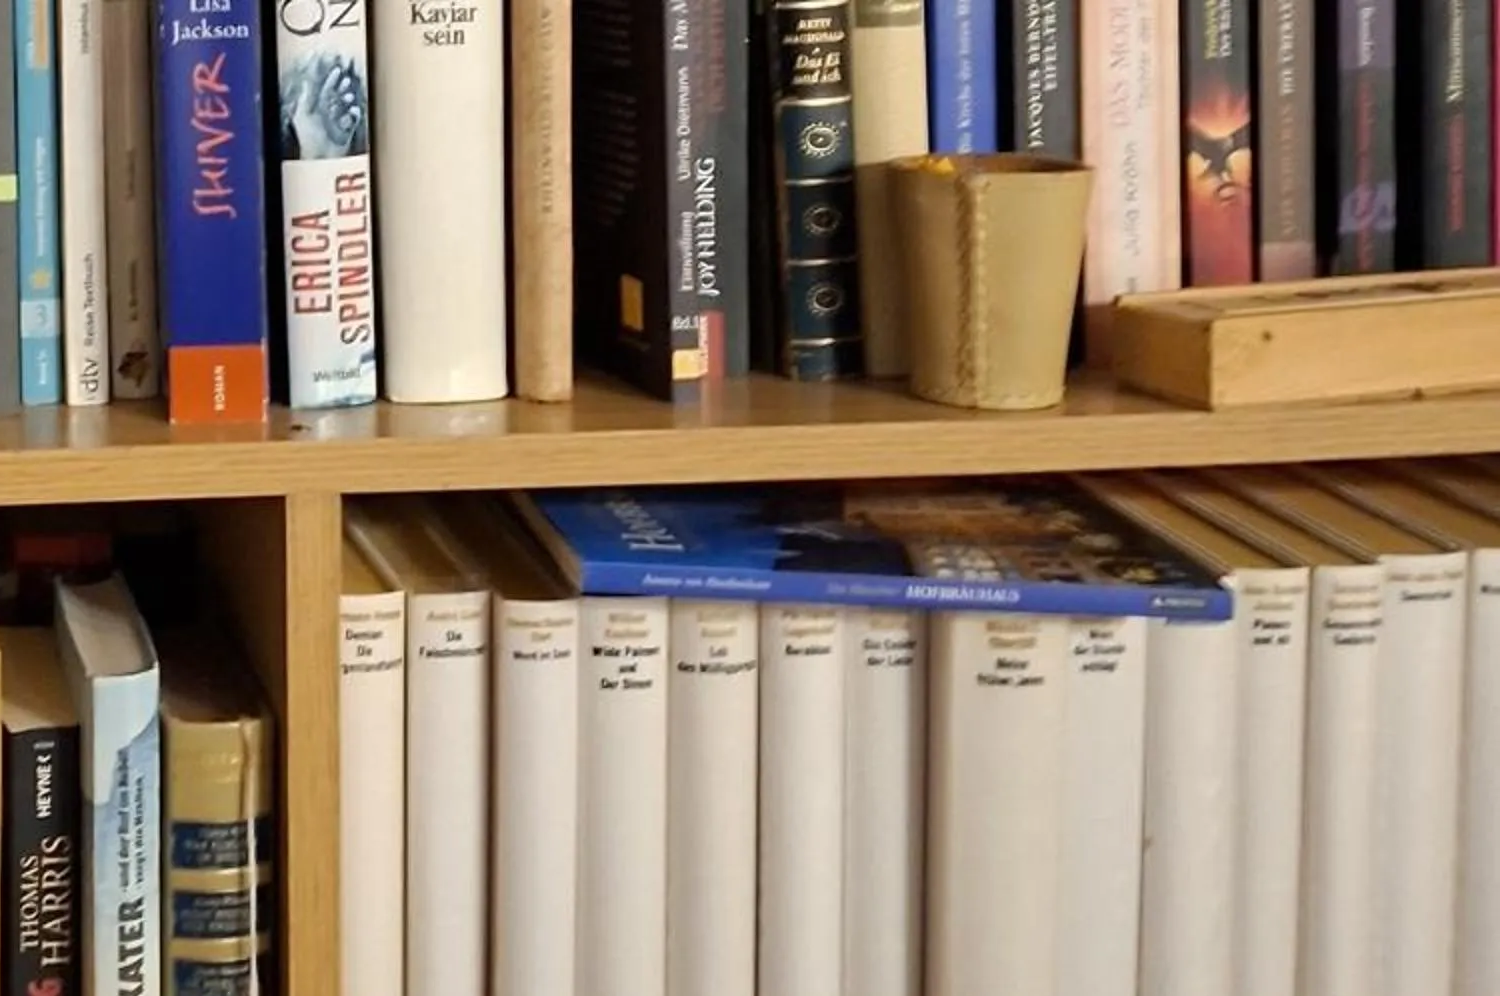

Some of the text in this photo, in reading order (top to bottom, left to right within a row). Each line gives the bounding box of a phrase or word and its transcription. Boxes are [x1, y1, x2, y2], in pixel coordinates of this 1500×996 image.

[171, 18, 250, 46] Jackson
[410, 2, 478, 25] Kaviar
[423, 24, 466, 46] sein
[795, 51, 841, 70] Das Ei
[190, 51, 238, 219] SHIVER
[1027, 68, 1045, 148] JACQUES
[291, 209, 333, 315] ERICA
[335, 171, 372, 346] SPINDLER
[694, 157, 720, 296] JOY FIELDING
[79, 357, 99, 394] dtv
[213, 365, 226, 411] ROMAN
[20, 854, 40, 953] THOMAS
[36, 763, 71, 967] HARRIS HEYNE
